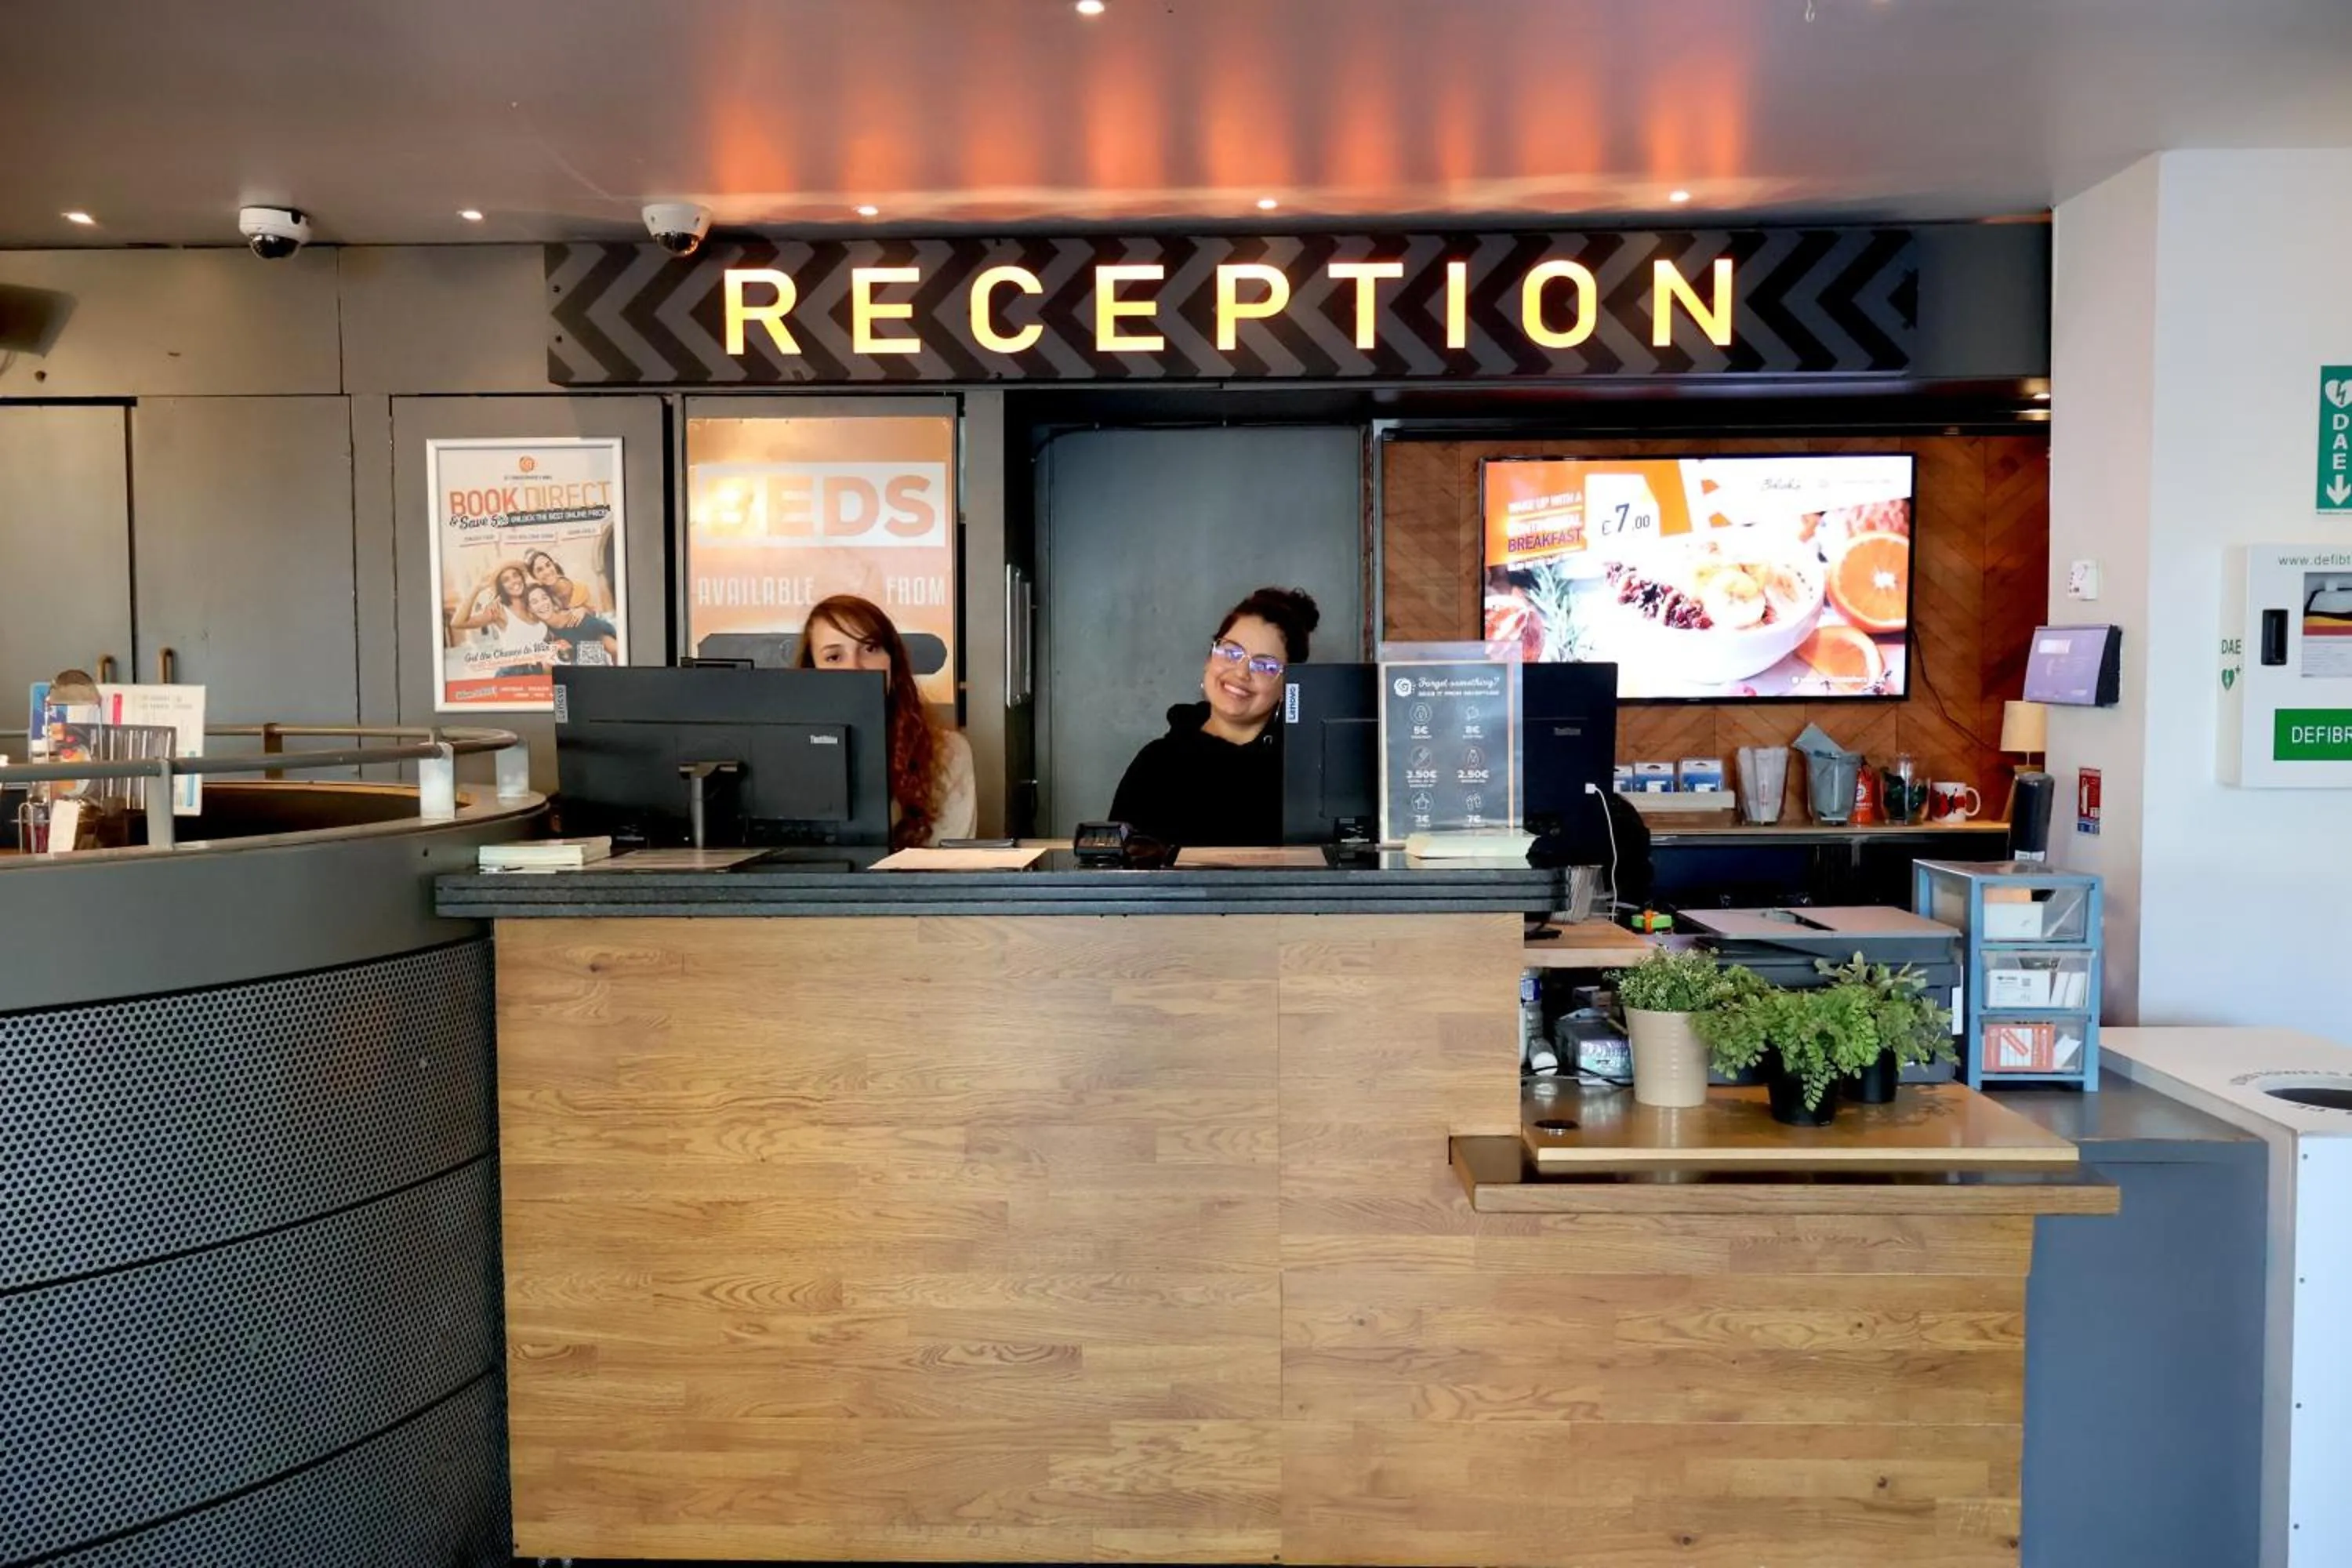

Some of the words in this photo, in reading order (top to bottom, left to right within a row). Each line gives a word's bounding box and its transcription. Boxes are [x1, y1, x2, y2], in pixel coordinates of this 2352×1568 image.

[724, 258, 1734, 356] RECEPTION
[2332, 413, 2350, 470] DAE
[449, 487, 519, 516] BOOK
[524, 481, 612, 511] DIRECT
[706, 475, 935, 538] BEDS
[449, 516, 459, 528] &
[459, 515, 488, 529] Save
[1508, 528, 1581, 552] BREAKFAST
[698, 576, 815, 607] AVAILABLE
[887, 576, 945, 607] FROM
[2221, 639, 2241, 654] DAE
